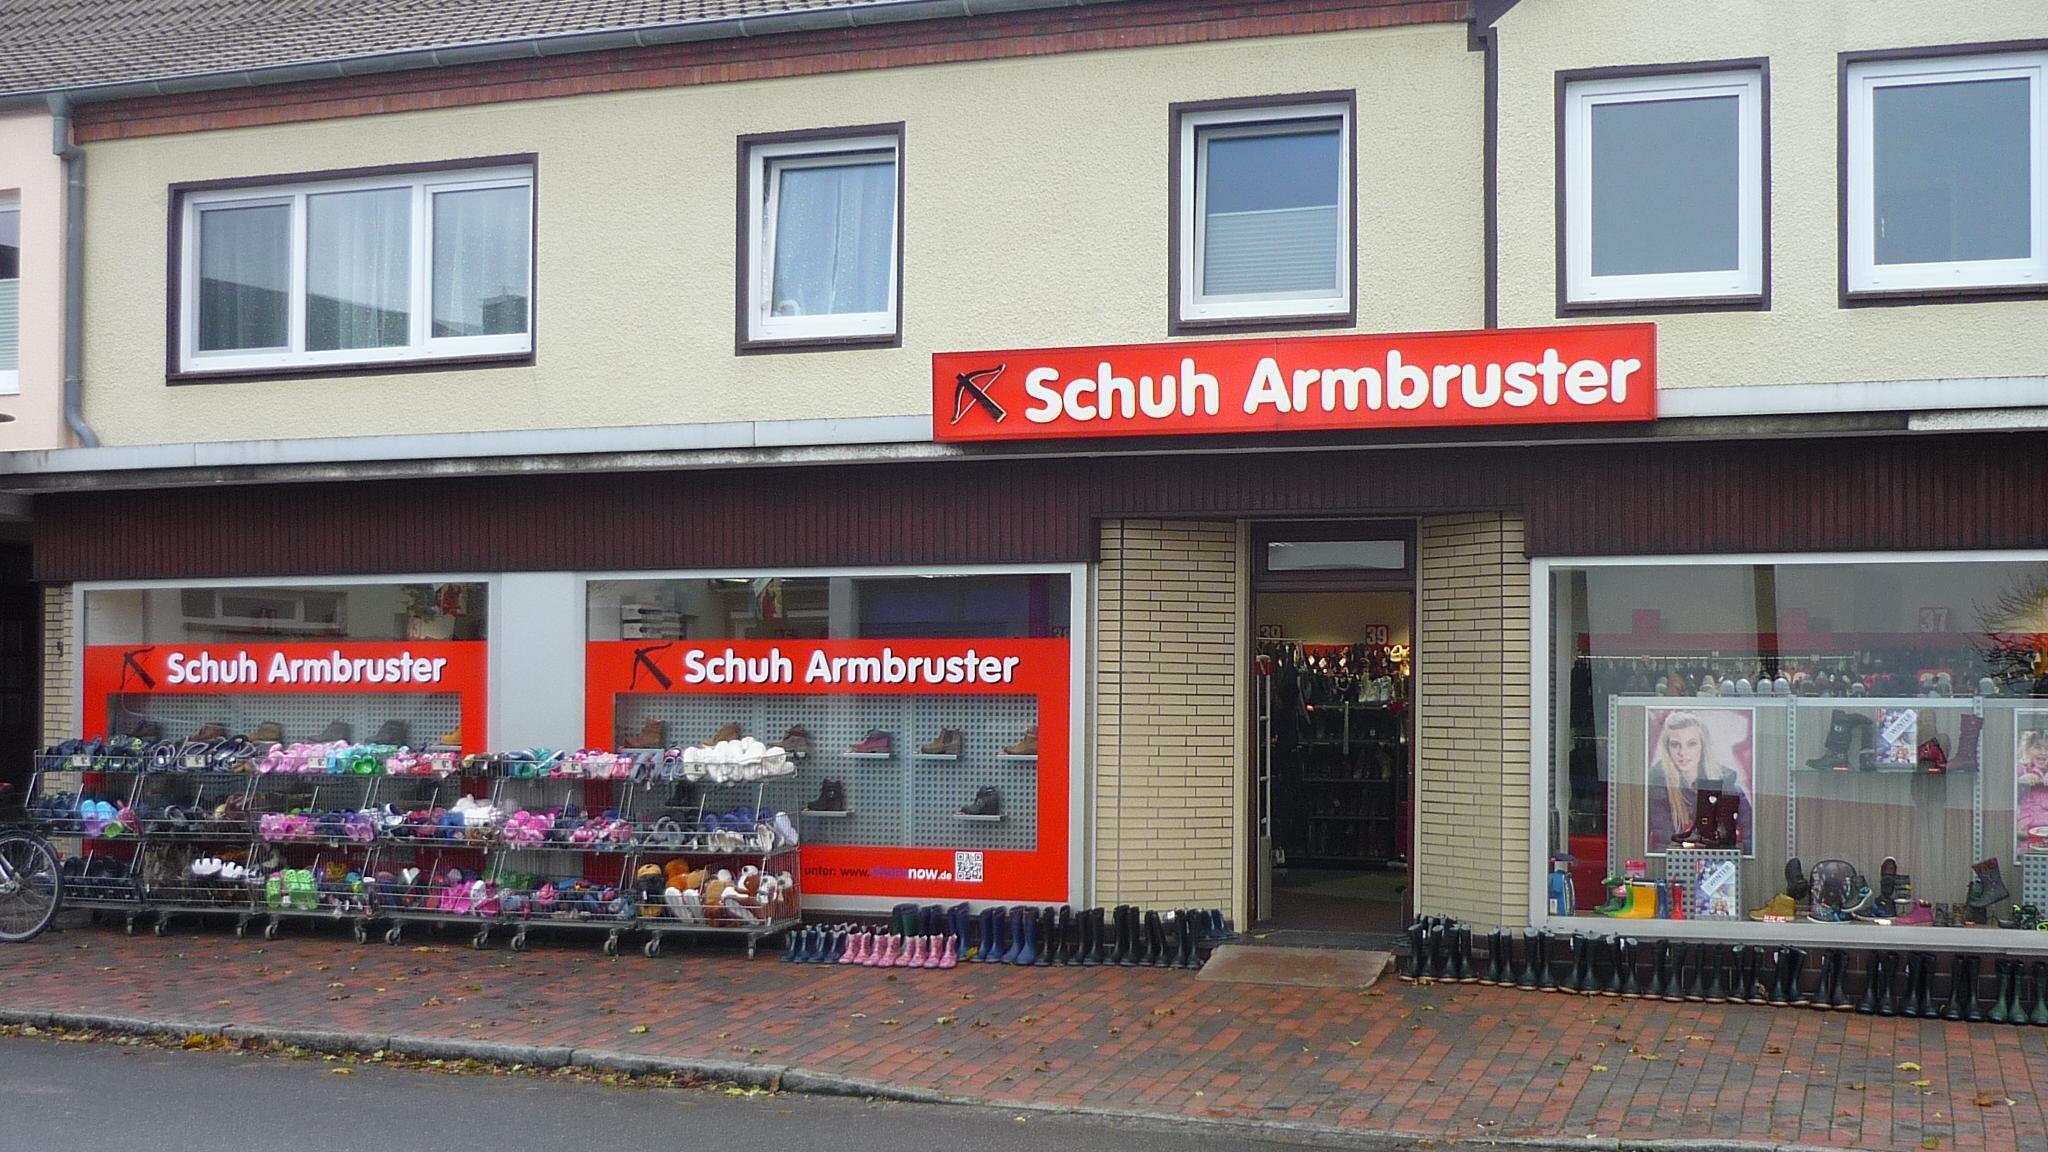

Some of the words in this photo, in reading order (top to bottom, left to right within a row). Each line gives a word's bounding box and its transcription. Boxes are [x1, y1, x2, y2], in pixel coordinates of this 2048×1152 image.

[1024, 358, 1220, 422] Schuh
[1243, 348, 1641, 414] Armbruster
[1366, 626, 1388, 645] 39
[167, 650, 258, 684] Schuh
[268, 650, 447, 683] Armbruster
[684, 648, 792, 683] Schuh
[805, 648, 1020, 683] Armbruster
[804, 866, 836, 877] unter:
